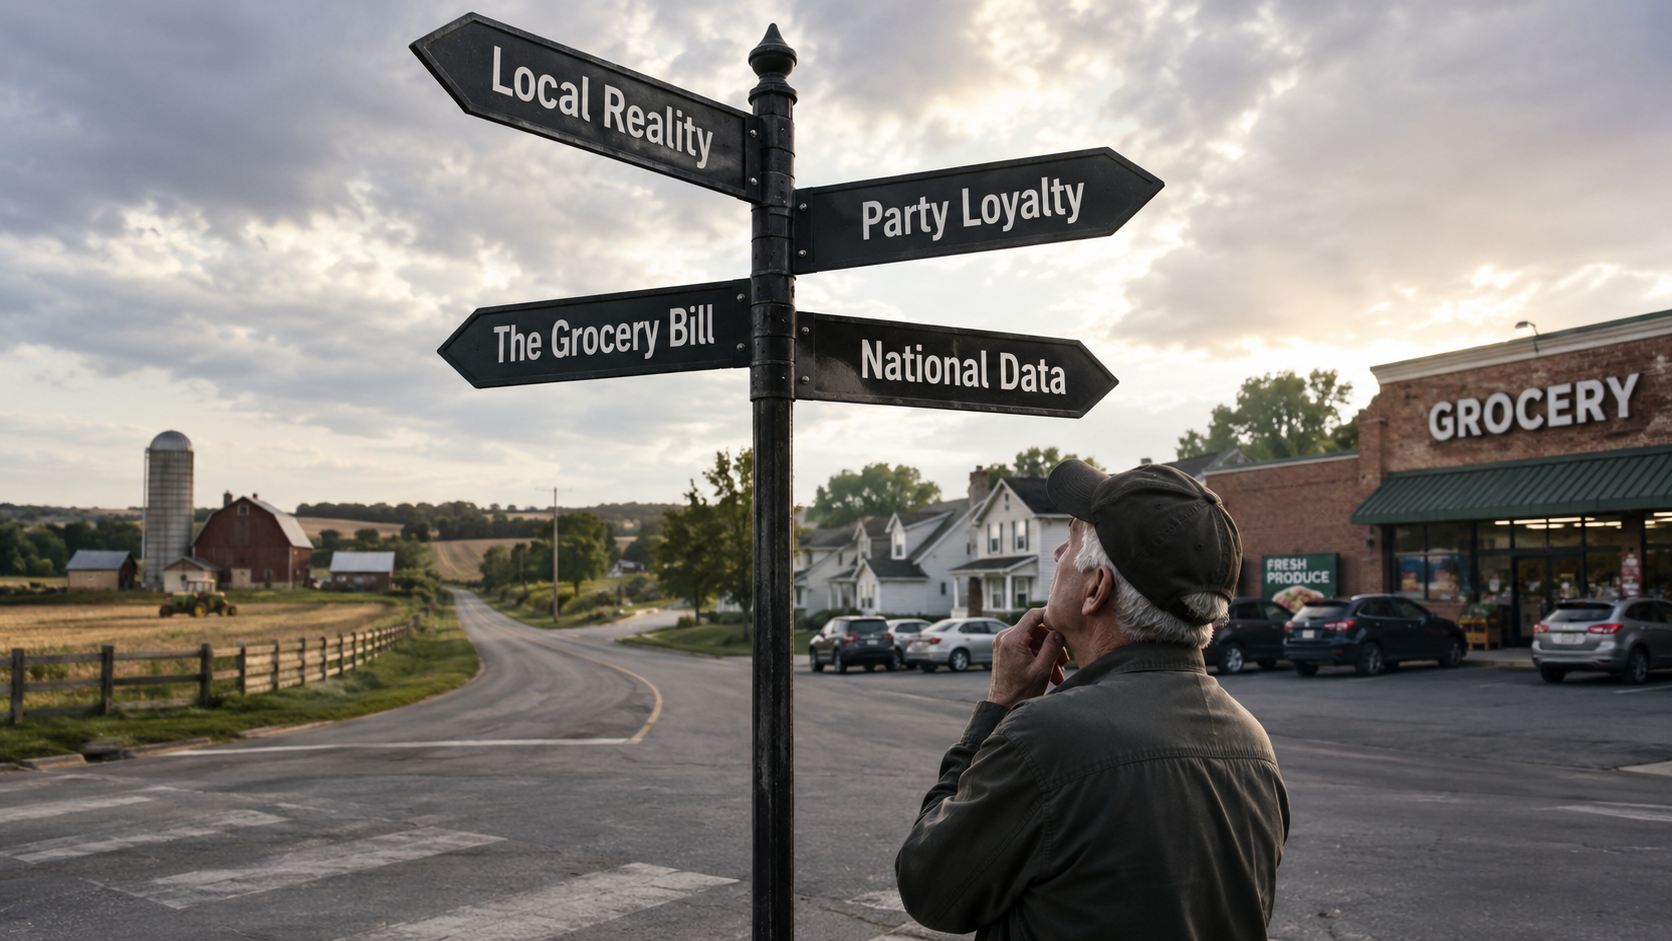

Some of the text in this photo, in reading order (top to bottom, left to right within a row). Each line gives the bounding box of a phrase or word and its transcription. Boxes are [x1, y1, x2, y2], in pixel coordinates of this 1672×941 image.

[492, 45, 715, 170] Local Reality
[862, 176, 1085, 242] Party Loyalty
[493, 303, 715, 364] The Grocery Bill
[861, 339, 1067, 395] National Data
[1428, 373, 1640, 441] GROCERY
[1266, 558, 1307, 571] FRESH
[1266, 571, 1330, 584] PRODUCE
